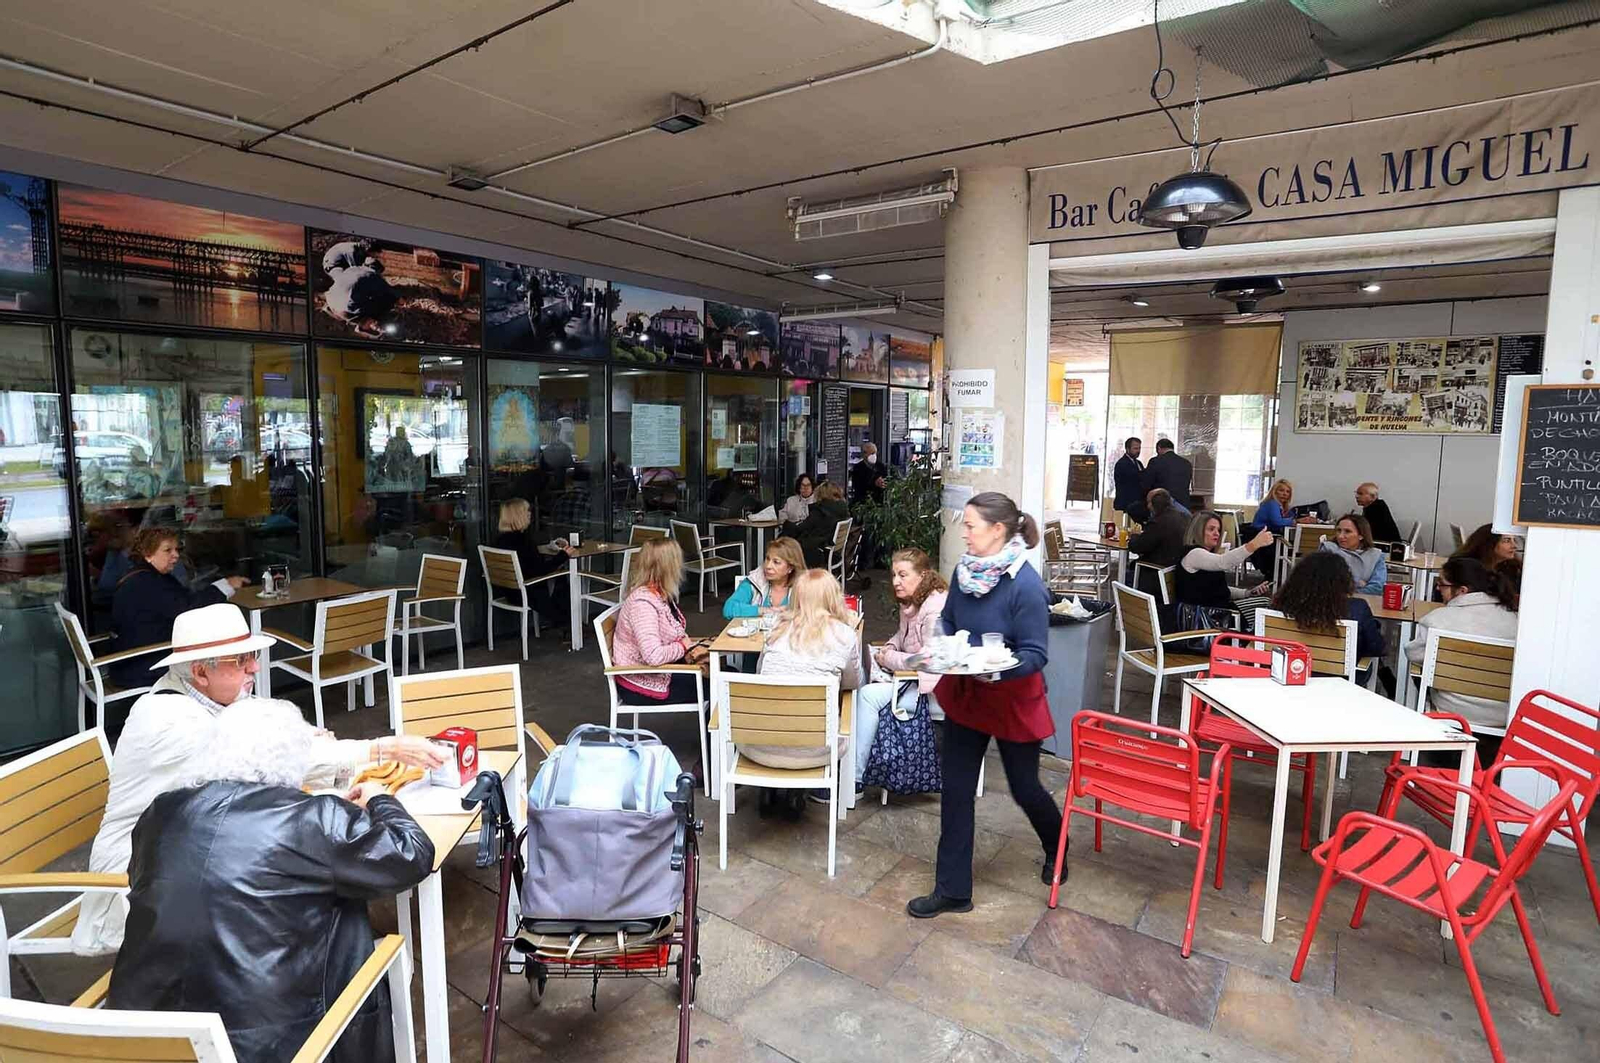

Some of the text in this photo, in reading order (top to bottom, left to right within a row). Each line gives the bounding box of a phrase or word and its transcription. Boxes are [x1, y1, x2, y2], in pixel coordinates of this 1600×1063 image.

[1048, 193, 1098, 231] Bar
[1258, 156, 1366, 209] CASA
[1379, 123, 1590, 195] MIGUEL
[951, 380, 989, 388] PROHIBIDO
